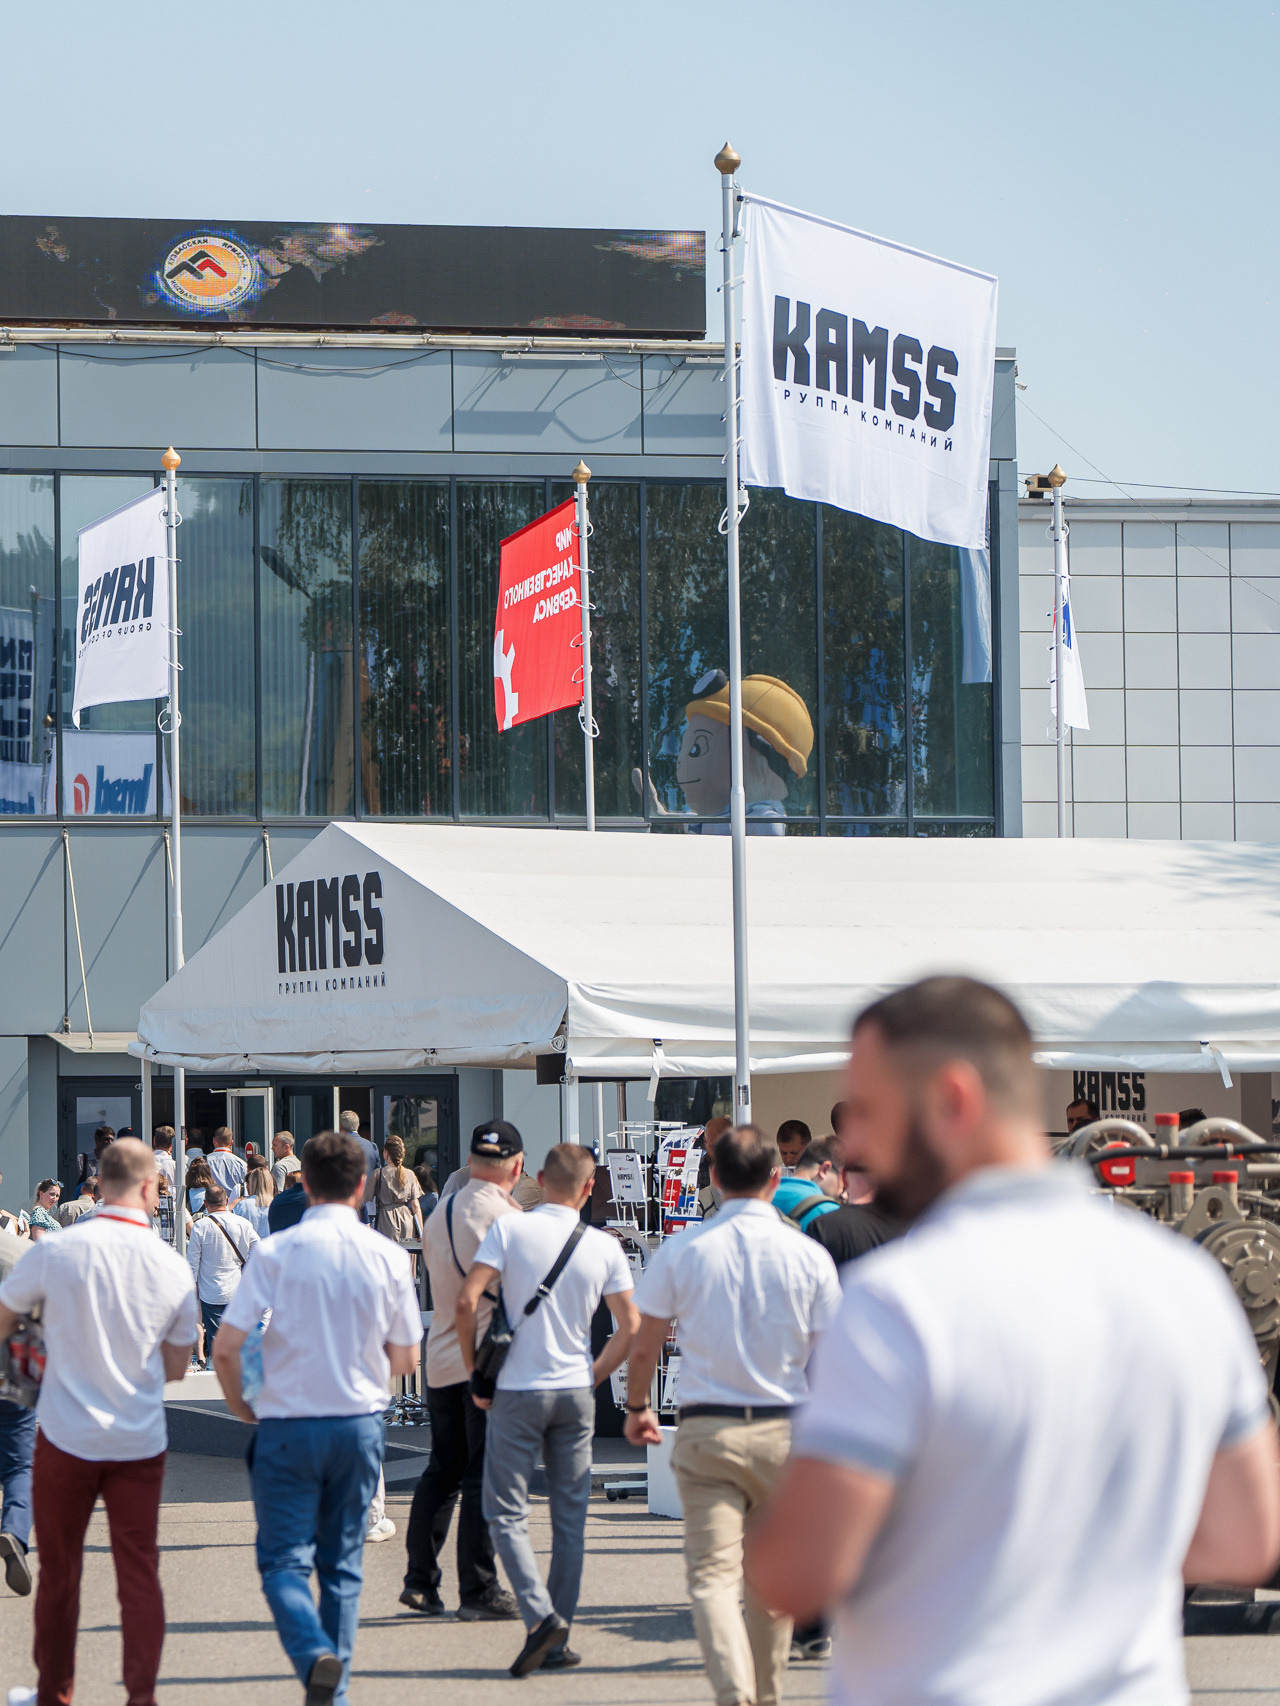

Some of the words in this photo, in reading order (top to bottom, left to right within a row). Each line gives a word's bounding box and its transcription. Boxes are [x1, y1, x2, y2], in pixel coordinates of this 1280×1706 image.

[773, 295, 959, 432] KAMSS
[775, 386, 849, 416] РУППА
[861, 411, 953, 451] КОМПАНИЙ
[276, 871, 385, 973] KAMSS
[279, 981, 319, 995] ГРУППА
[326, 971, 386, 991] КОМПАНИЙ
[1073, 1071, 1146, 1111] KAMSS
